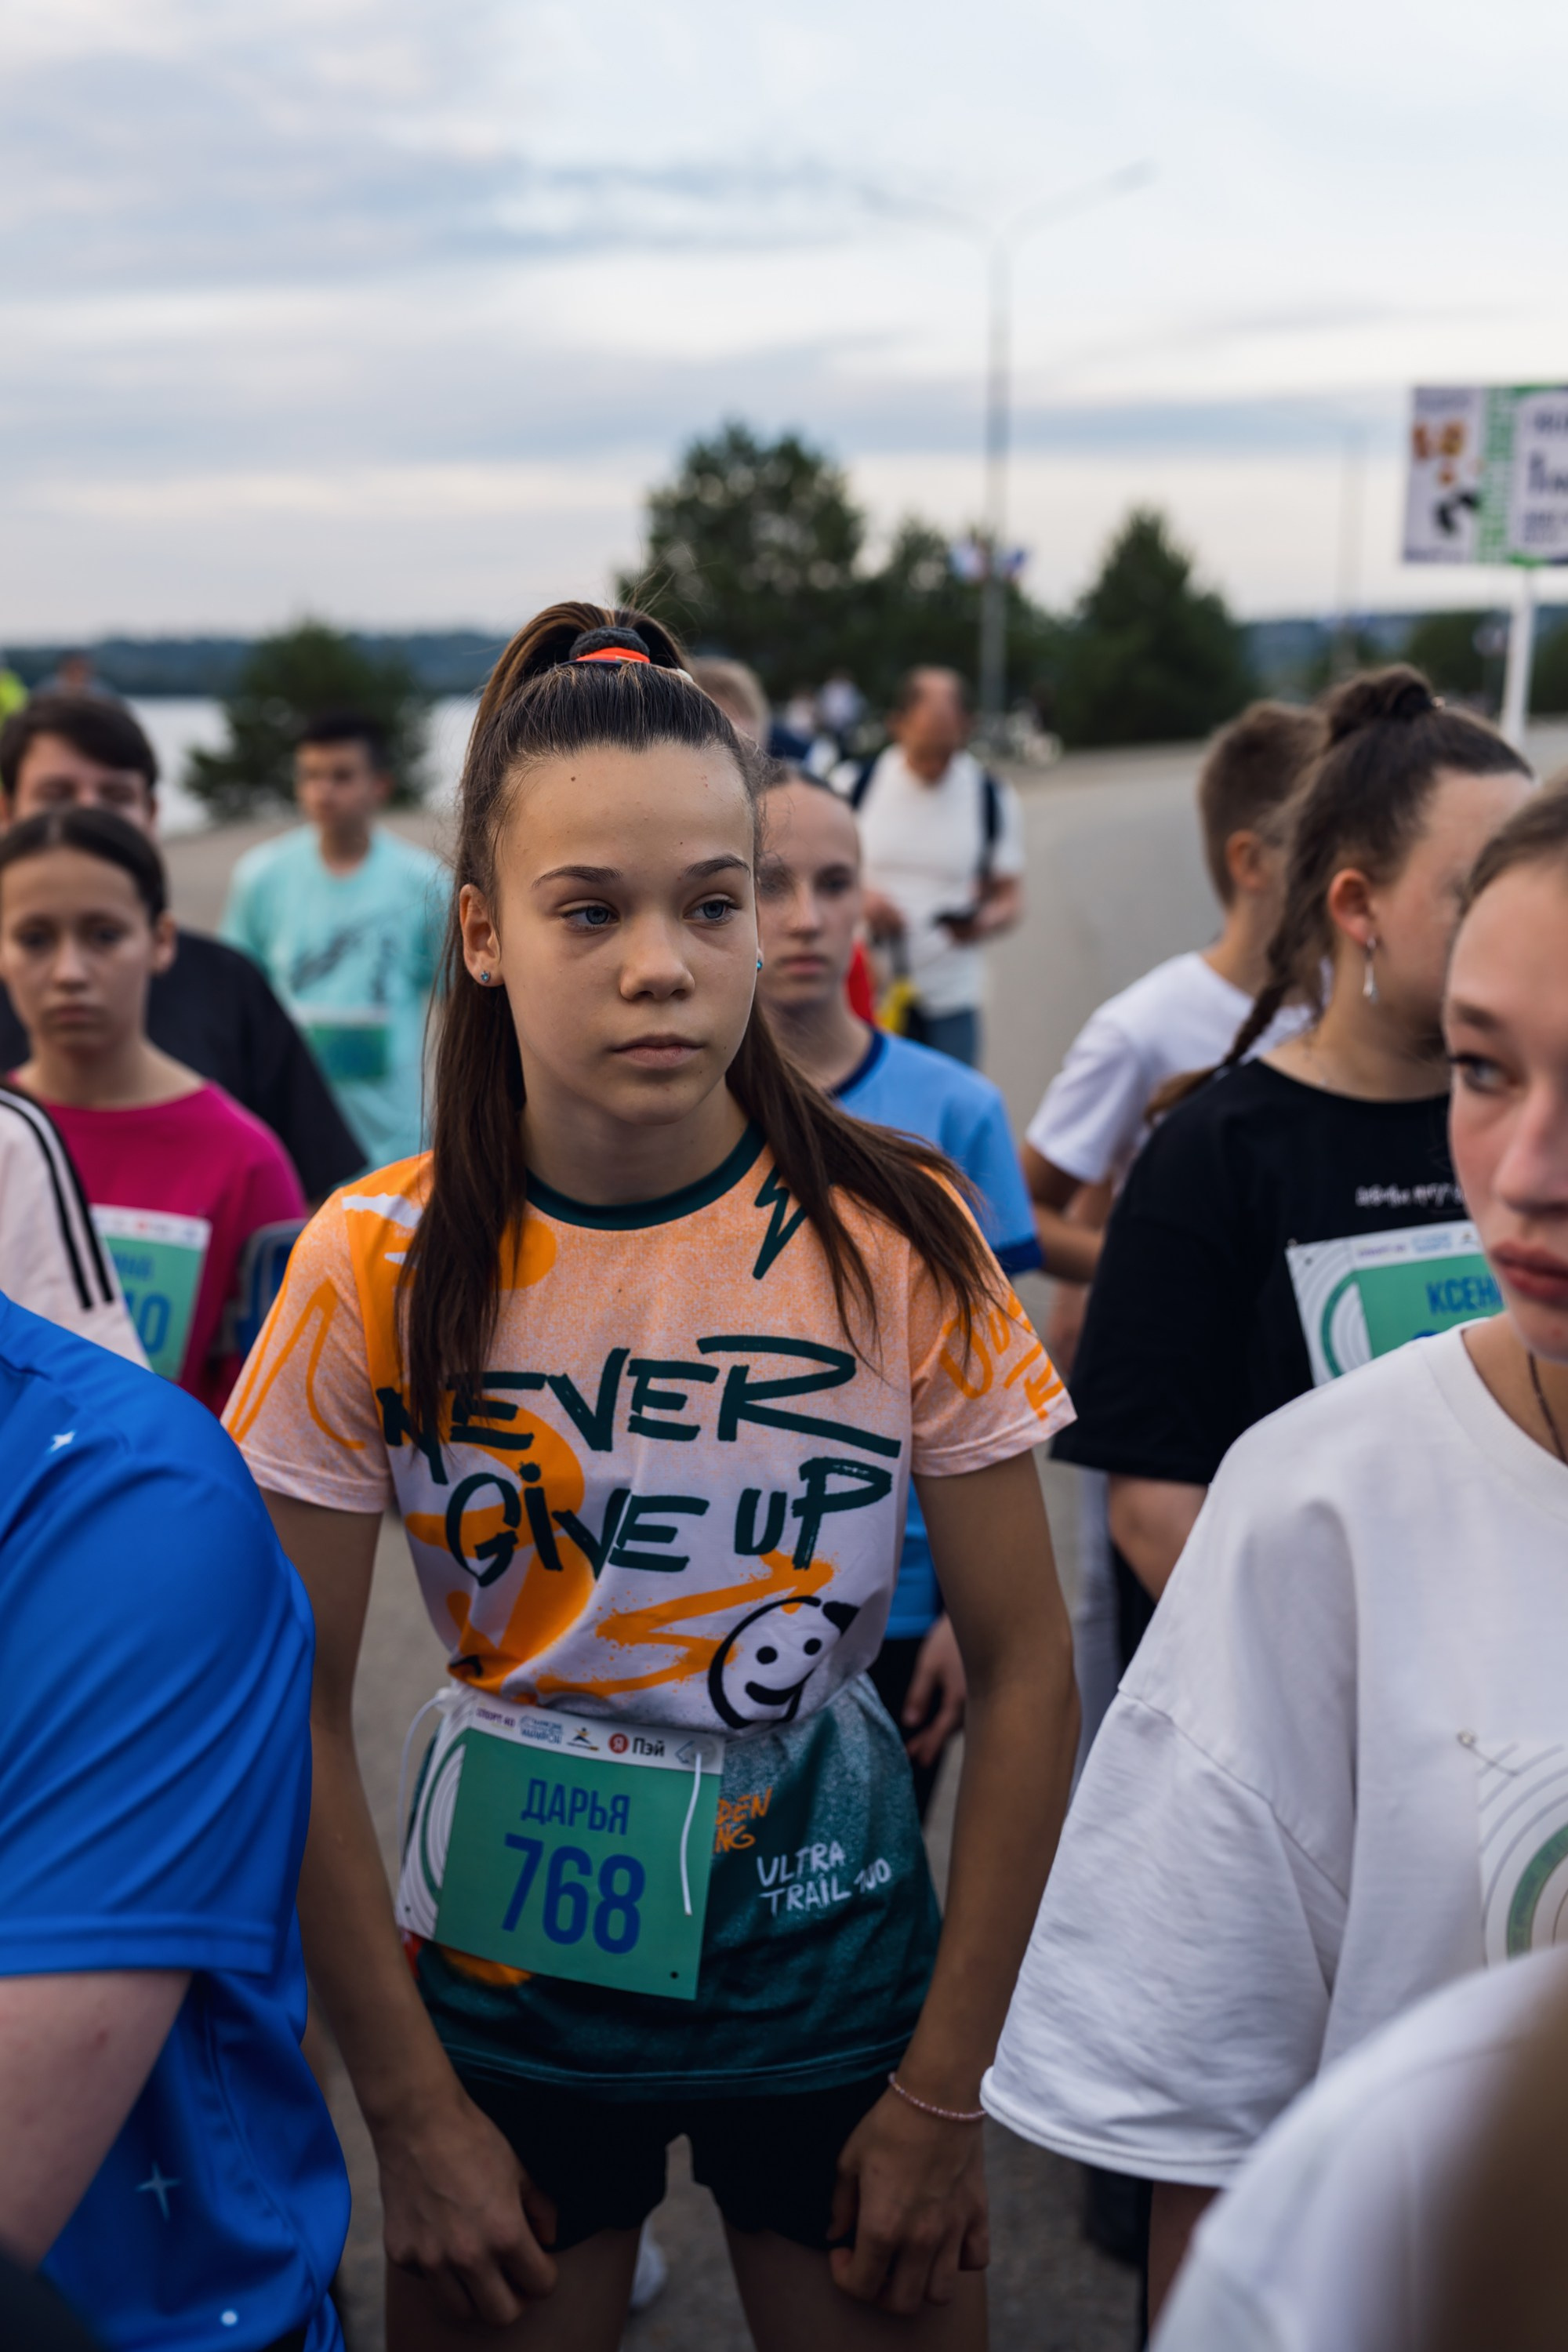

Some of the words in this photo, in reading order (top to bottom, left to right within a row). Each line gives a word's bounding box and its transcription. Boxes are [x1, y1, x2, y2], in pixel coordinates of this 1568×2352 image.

[376, 1334, 902, 1485] NEVER
[735, 1457, 892, 1570] UP
[633, 1737, 665, 1757] Пэй
[521, 1778, 630, 1835] ДАРЬЯ
[502, 1832, 646, 1955] 768
[757, 1840, 847, 1888] ULTRA
